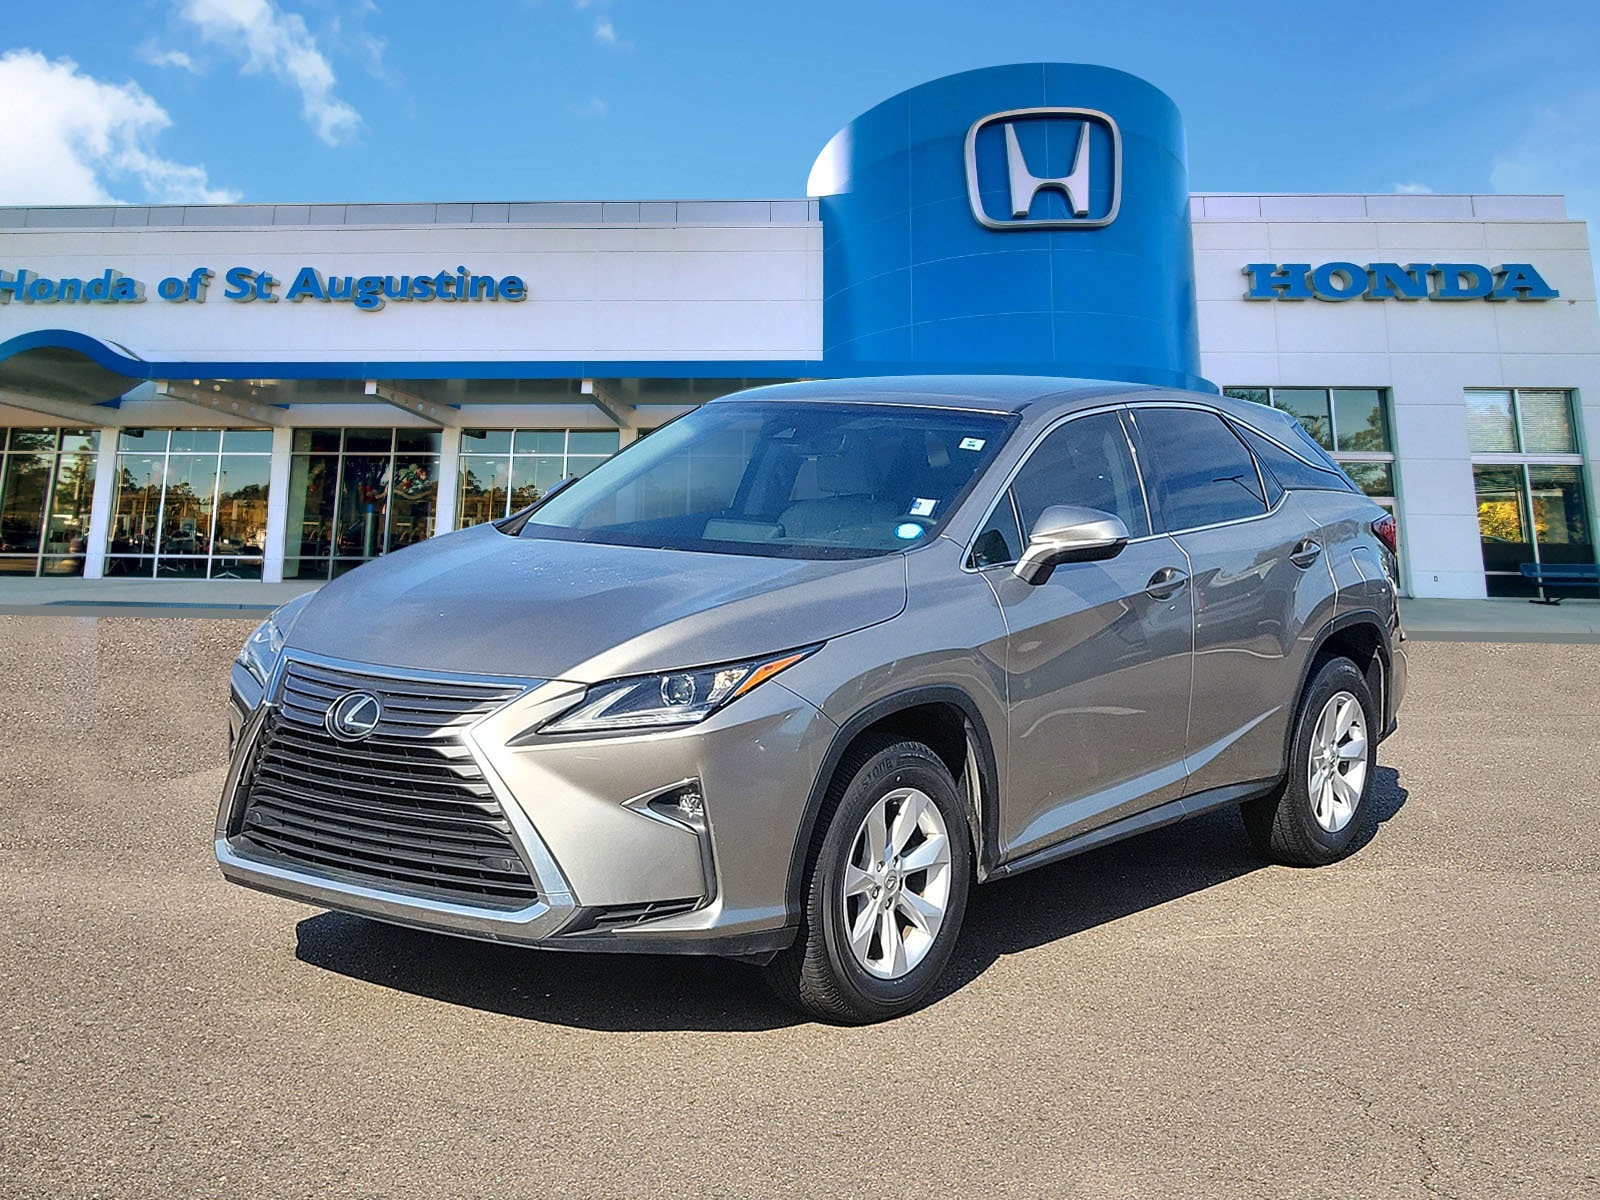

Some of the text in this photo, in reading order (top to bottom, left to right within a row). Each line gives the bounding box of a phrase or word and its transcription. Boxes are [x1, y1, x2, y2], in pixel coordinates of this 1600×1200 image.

[0, 265, 527, 312] Honda of St Augustine
[1242, 262, 1560, 302] HONDA
